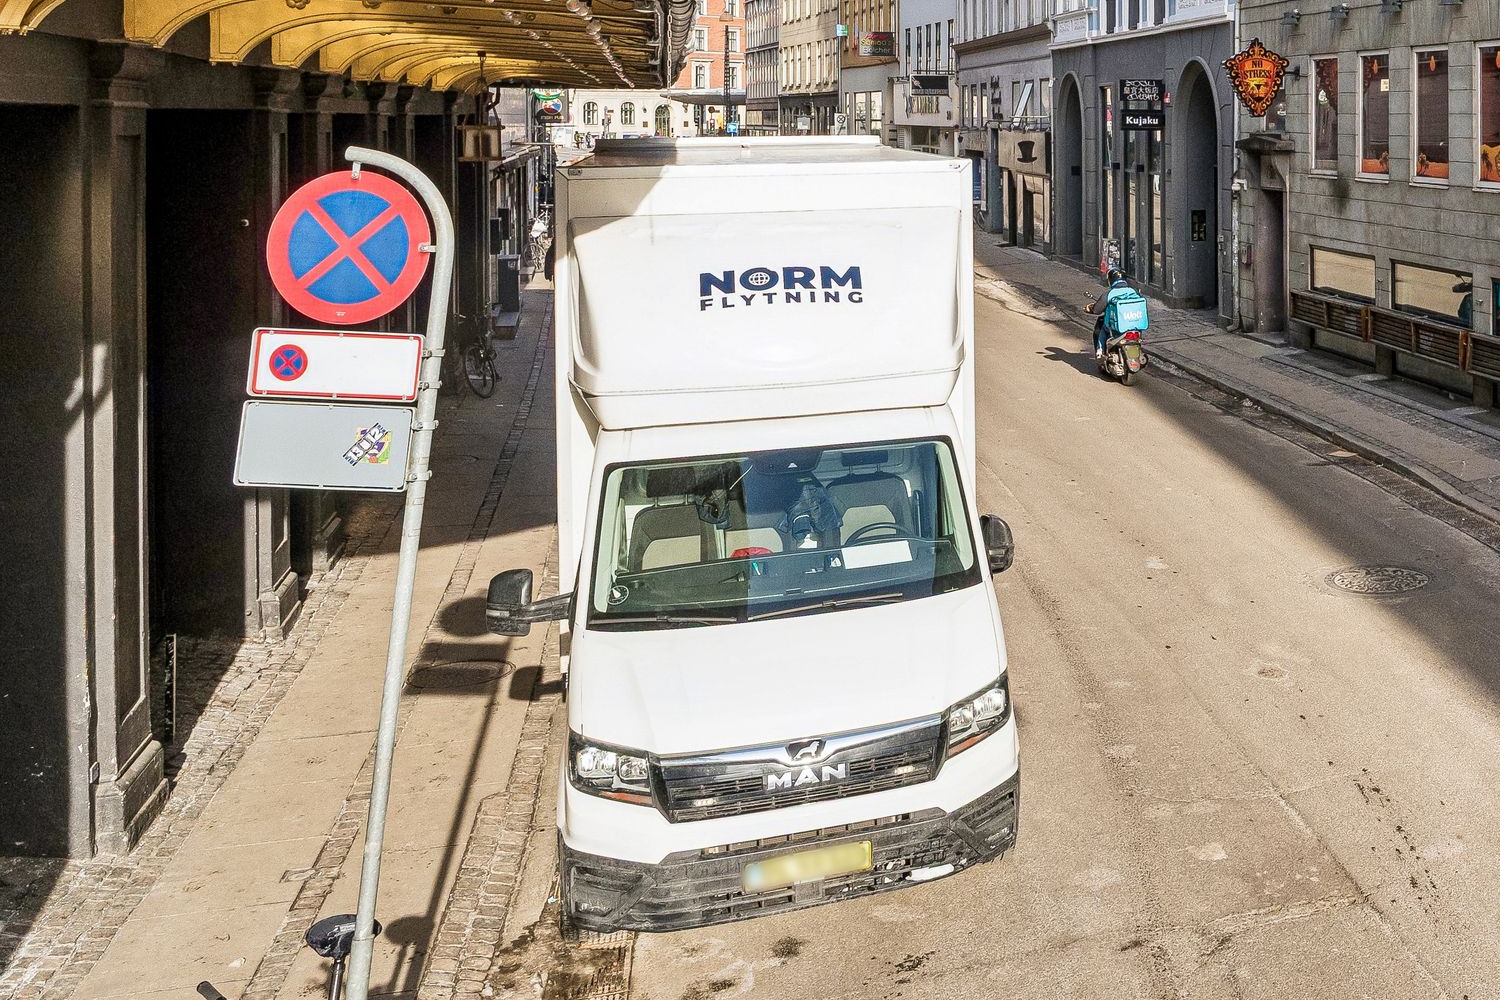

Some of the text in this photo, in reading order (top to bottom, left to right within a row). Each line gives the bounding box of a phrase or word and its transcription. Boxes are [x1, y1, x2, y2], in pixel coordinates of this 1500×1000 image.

[1252, 60, 1263, 68] NO
[1244, 70, 1272, 79] STRESS
[1126, 116, 1159, 126] Kujaku
[700, 266, 862, 297] NORM
[700, 291, 864, 312] FLYTNING
[1123, 311, 1143, 320] Wolt
[767, 763, 846, 791] MAN
